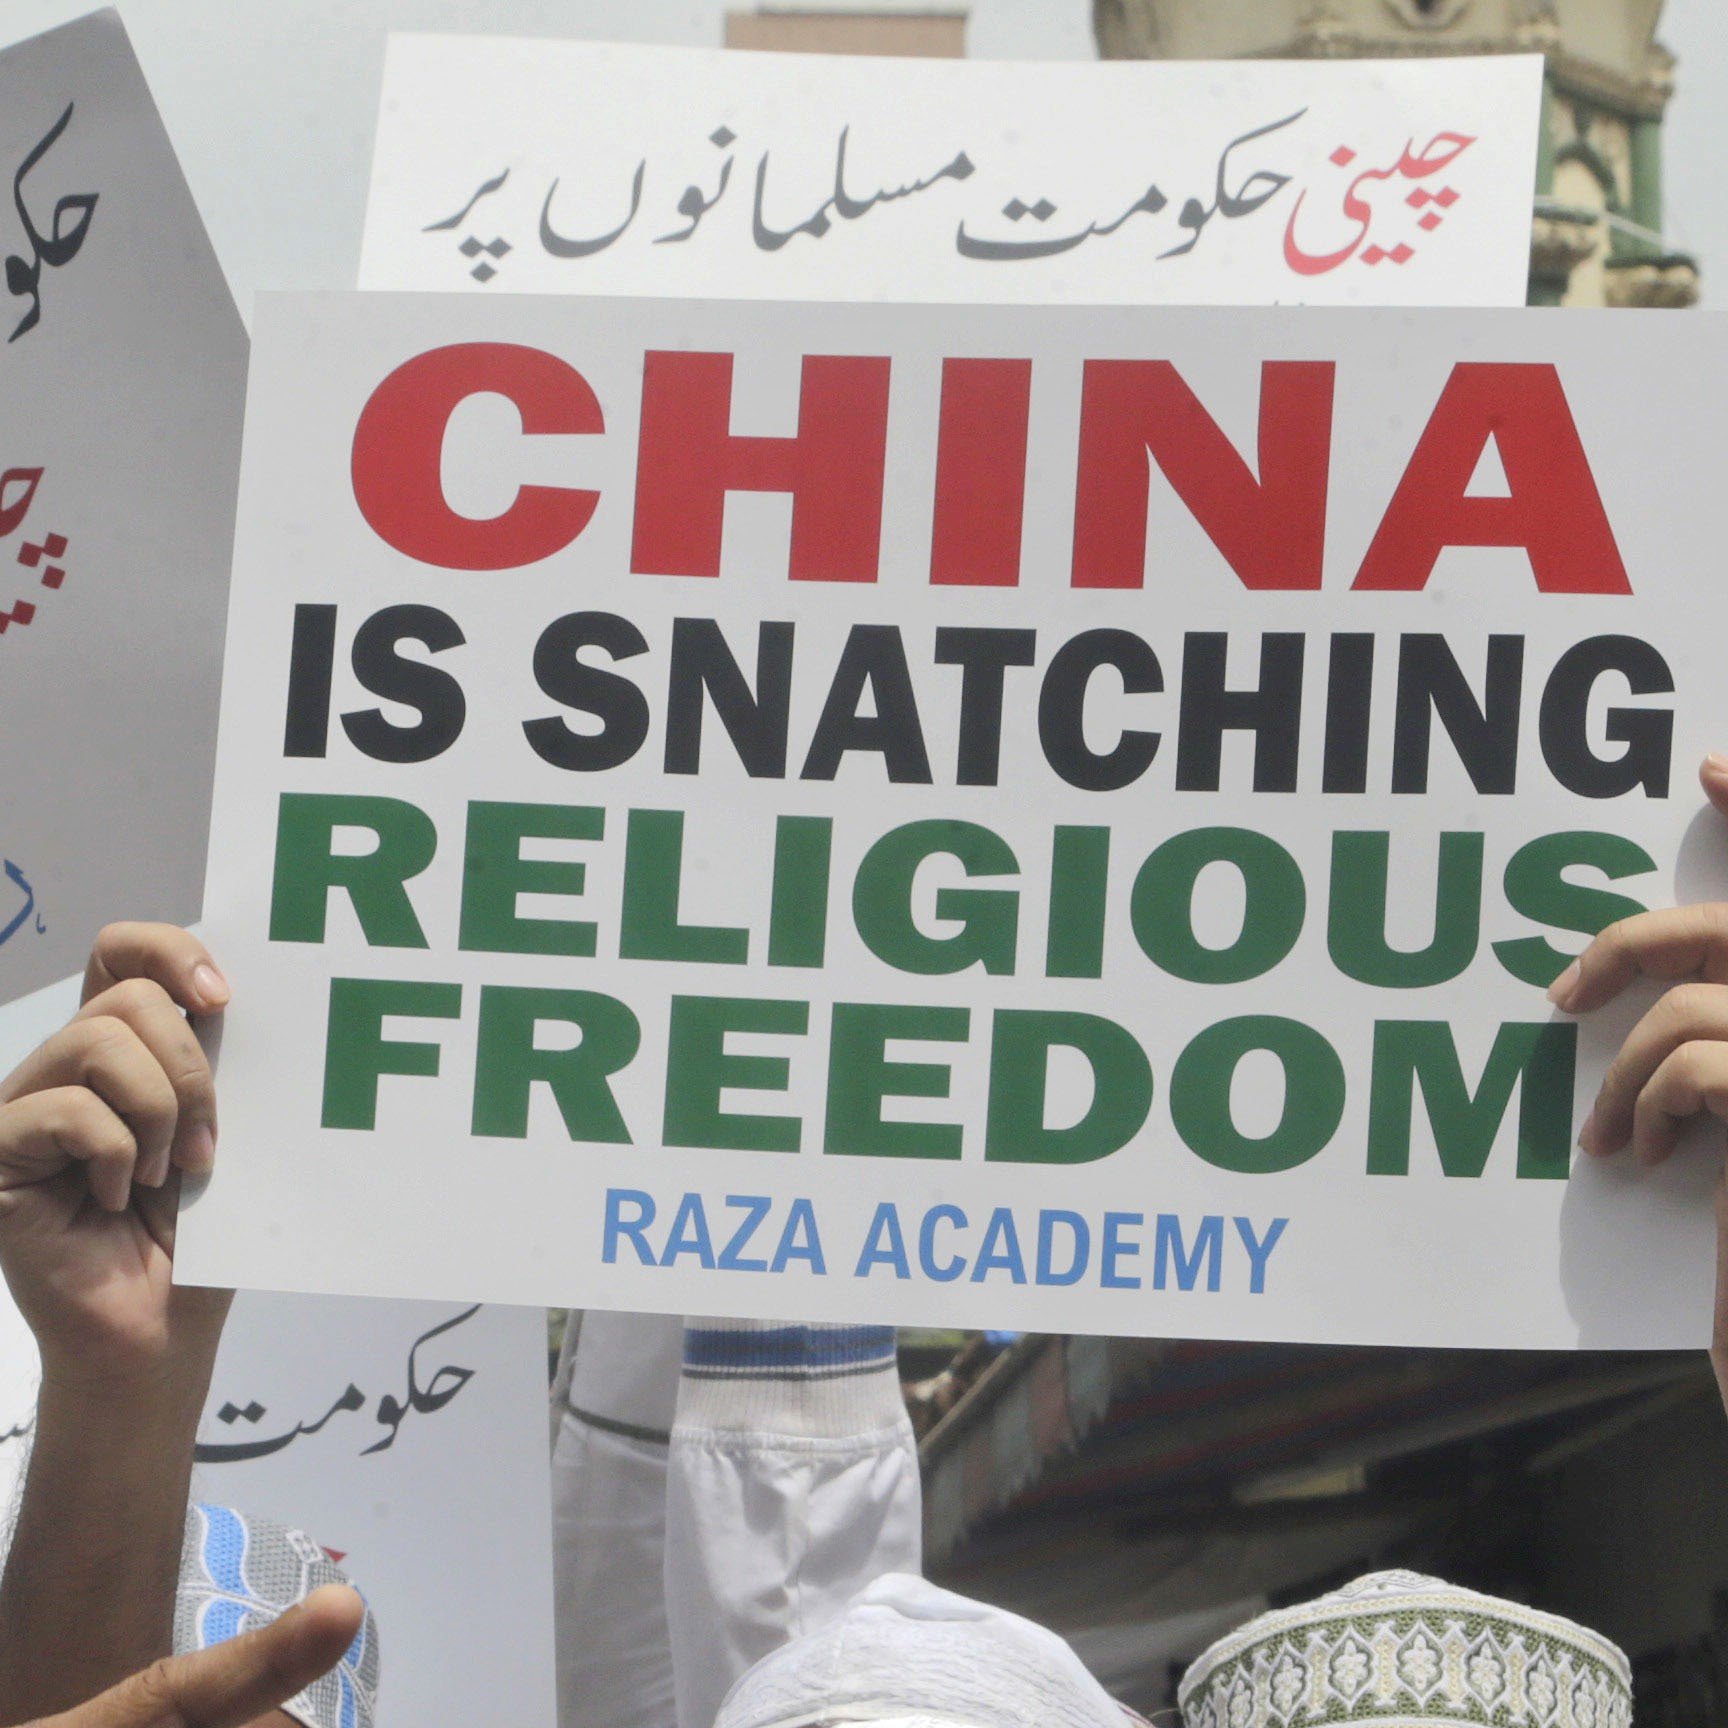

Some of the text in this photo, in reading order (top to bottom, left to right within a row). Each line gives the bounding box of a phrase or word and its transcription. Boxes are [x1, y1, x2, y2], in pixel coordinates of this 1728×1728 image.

[422, 107, 1478, 281] چینی حکومت مسلمانوں پر
[350, 341, 1634, 595] CHINA
[282, 602, 1677, 800] IS SNATCHING
[269, 791, 1657, 990] RELIGIOUS
[318, 976, 1579, 1180] FREEDOM
[601, 1186, 1289, 1295] RAZA ACADEMY
